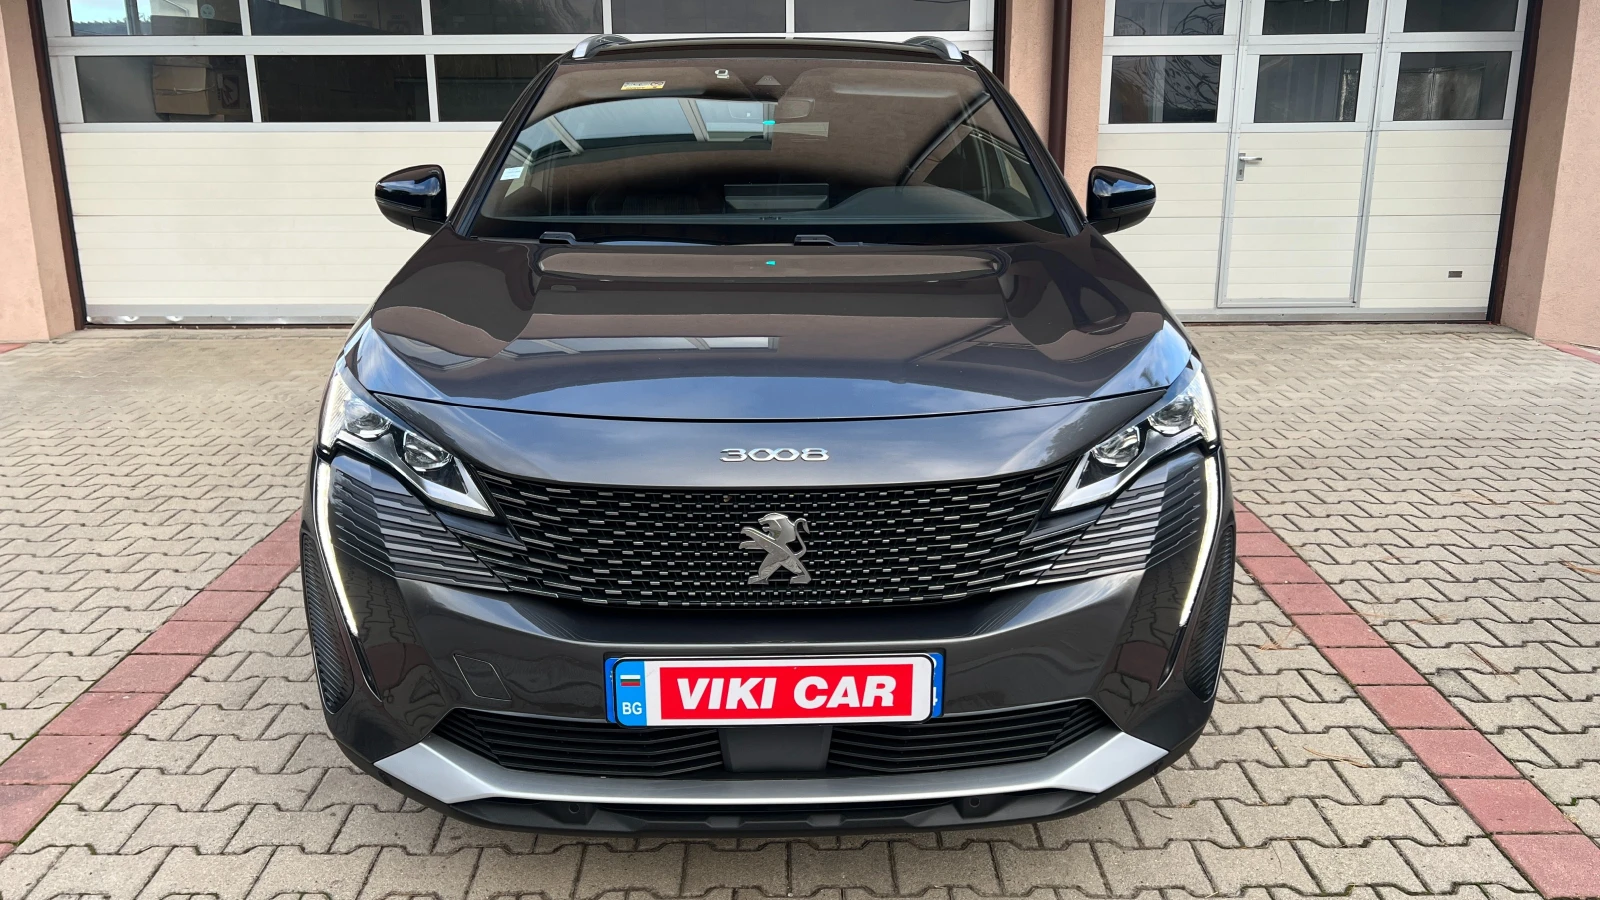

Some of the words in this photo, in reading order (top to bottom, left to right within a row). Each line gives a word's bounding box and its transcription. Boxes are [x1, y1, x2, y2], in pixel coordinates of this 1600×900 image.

[720, 447, 829, 462] 3008
[676, 677, 778, 710] VIKI
[793, 675, 897, 710] CAR
[622, 701, 643, 715] BG
